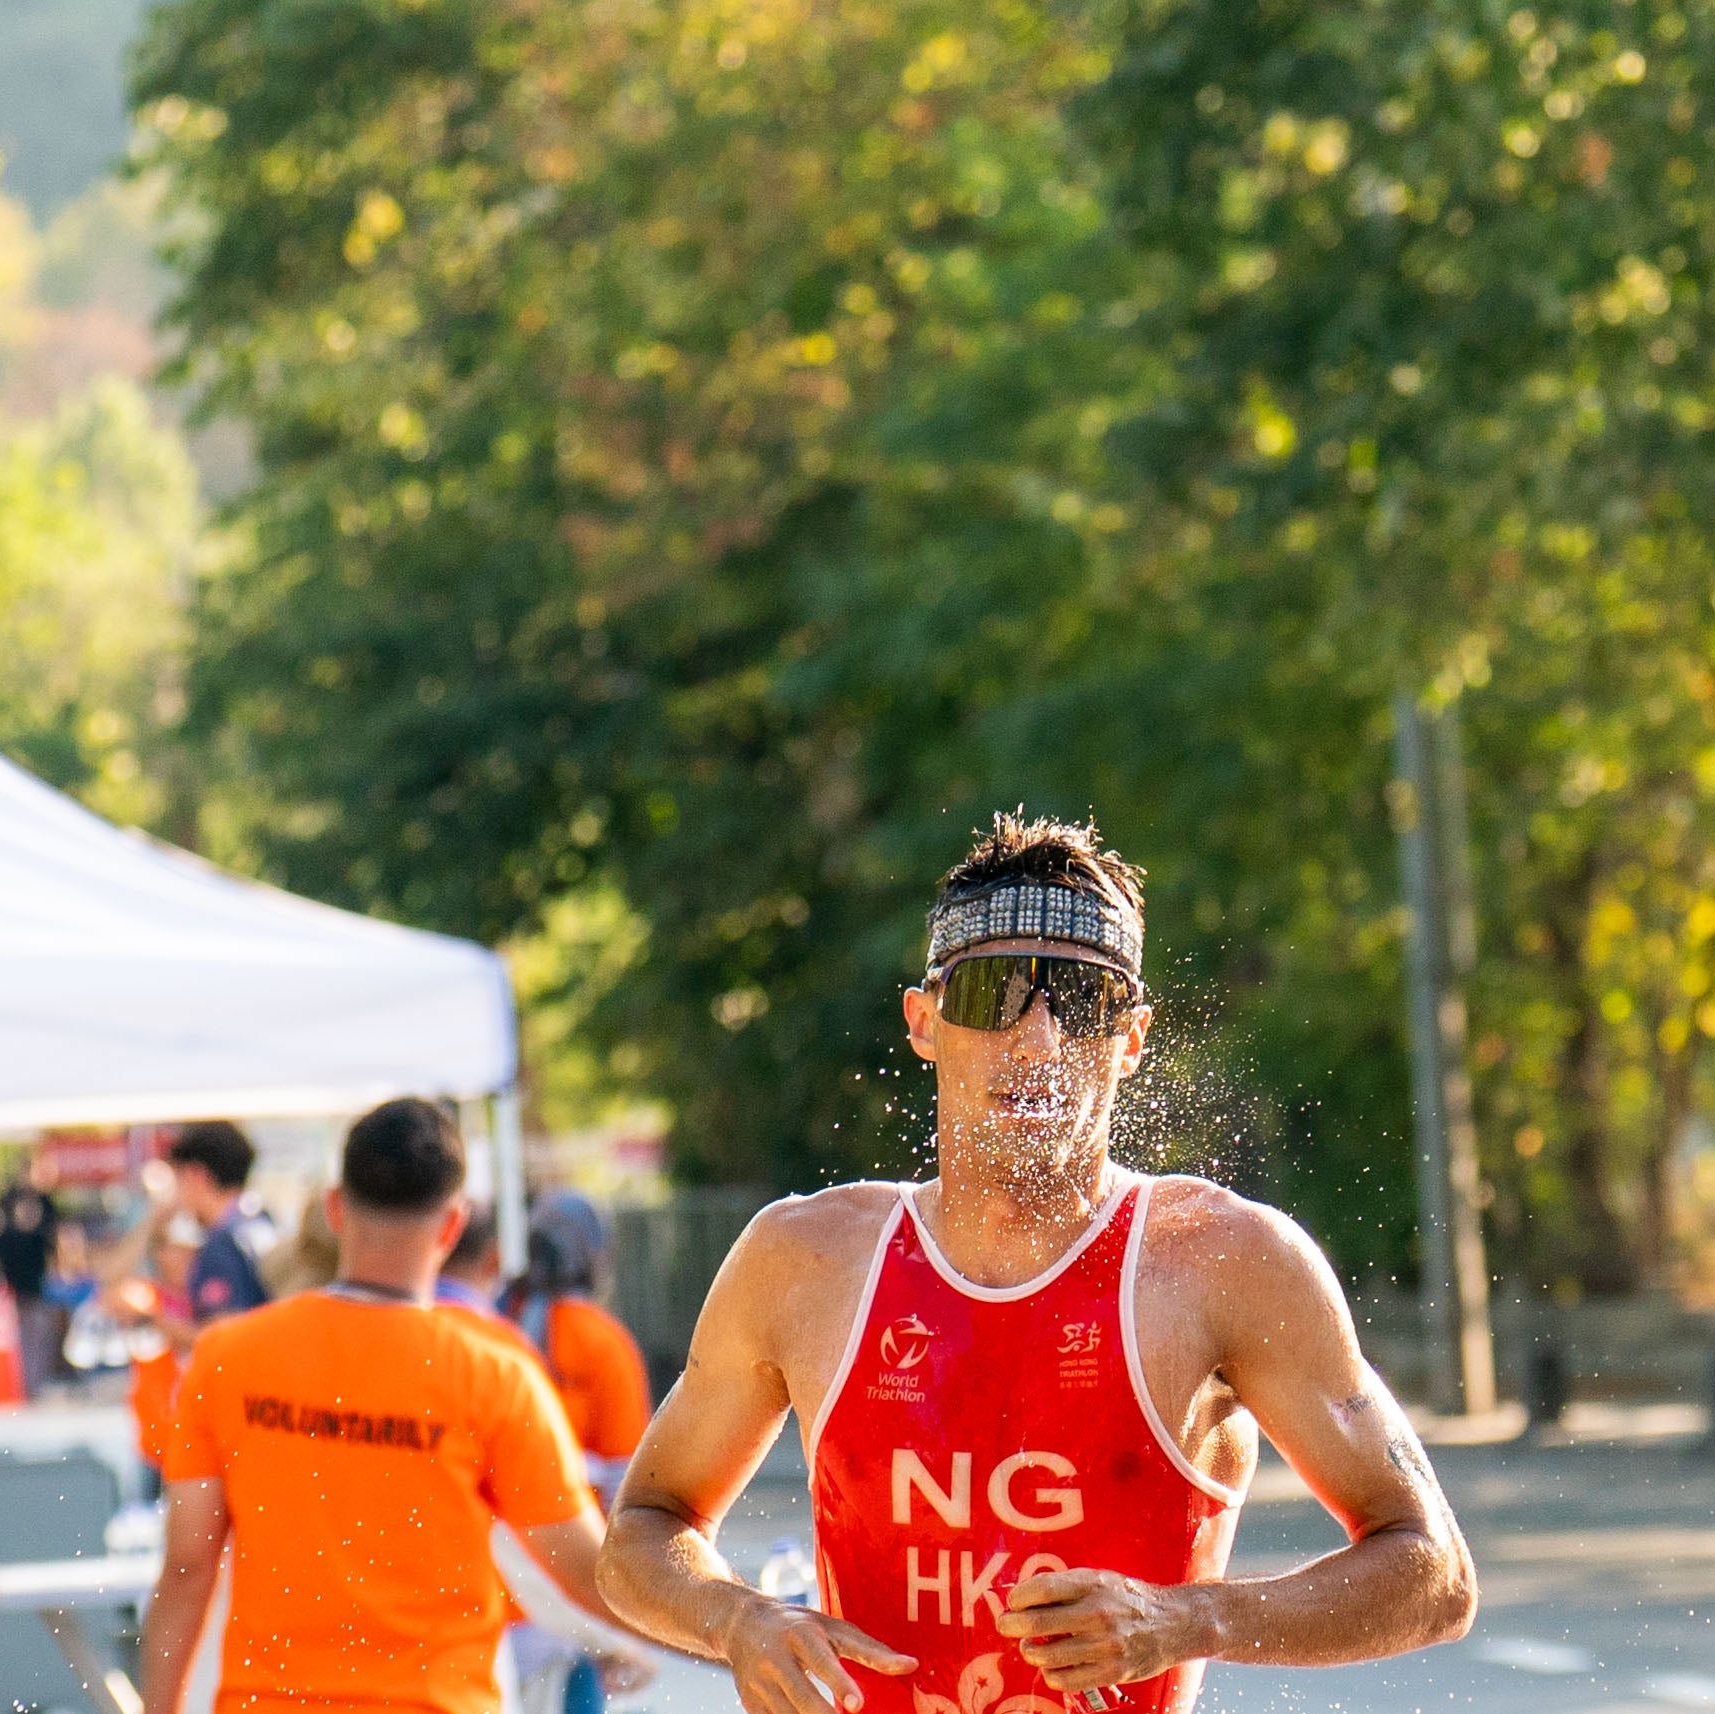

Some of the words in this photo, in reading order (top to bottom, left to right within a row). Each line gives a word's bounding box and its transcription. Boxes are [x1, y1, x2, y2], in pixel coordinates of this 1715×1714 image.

[866, 1386, 925, 1402] Triathlon
[878, 1372, 919, 1388] World
[242, 1394, 446, 1451] VOLUNTARILY
[892, 1448, 1084, 1532] NG
